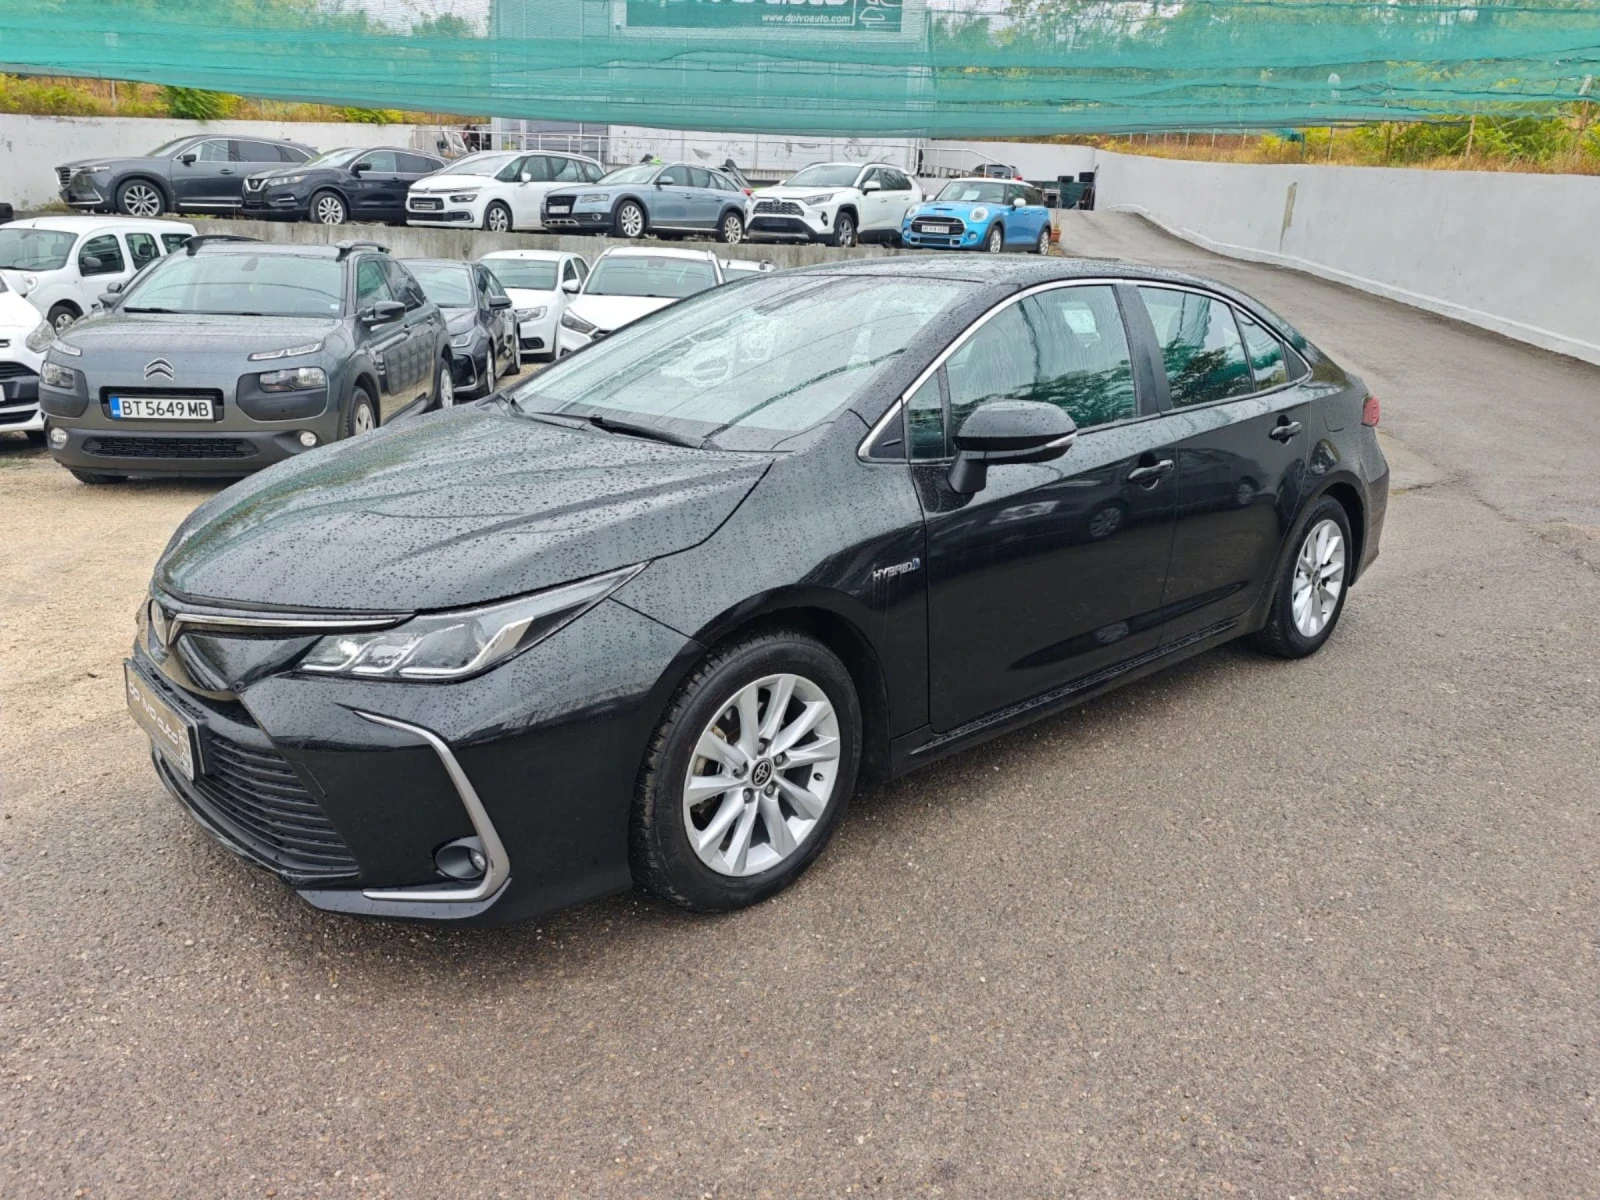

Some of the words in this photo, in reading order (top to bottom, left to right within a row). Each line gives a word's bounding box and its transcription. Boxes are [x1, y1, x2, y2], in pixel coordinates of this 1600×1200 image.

[761, 13, 851, 24] www.dpivoauto.com
[122, 401, 141, 416] BT
[145, 402, 184, 417] 5649
[187, 402, 209, 417] MB
[873, 562, 913, 580] HYBRID
